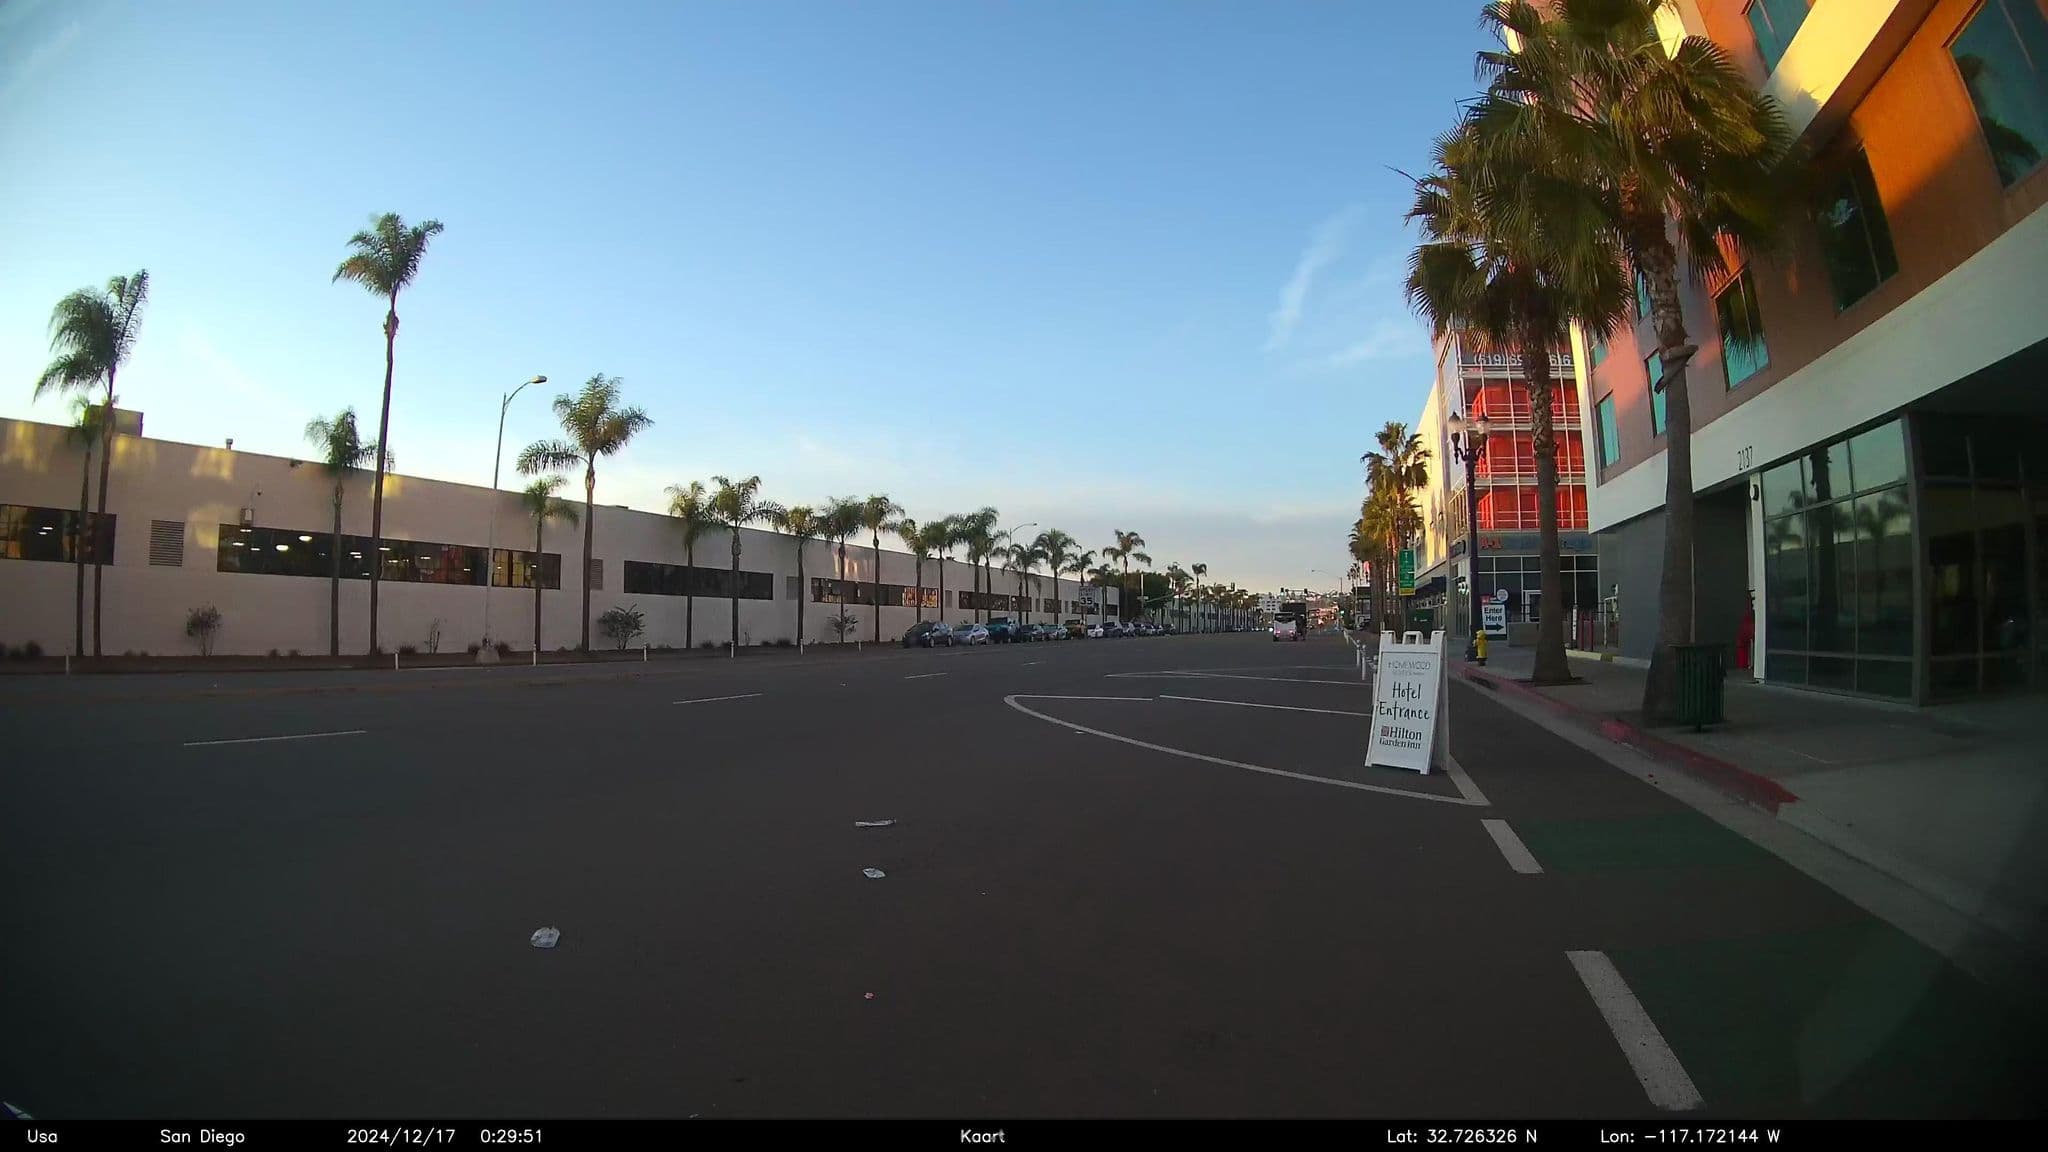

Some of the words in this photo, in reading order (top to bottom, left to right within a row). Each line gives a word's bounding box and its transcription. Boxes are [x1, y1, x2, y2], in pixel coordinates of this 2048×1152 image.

[1737, 446, 1753, 471] 2137
[1080, 597, 1093, 605] 35
[1484, 606, 1503, 614] Enter
[1485, 614, 1503, 622] Here
[1392, 681, 1421, 701] Hotel
[1379, 701, 1431, 720] Entrance
[1390, 726, 1422, 741] Hilton
